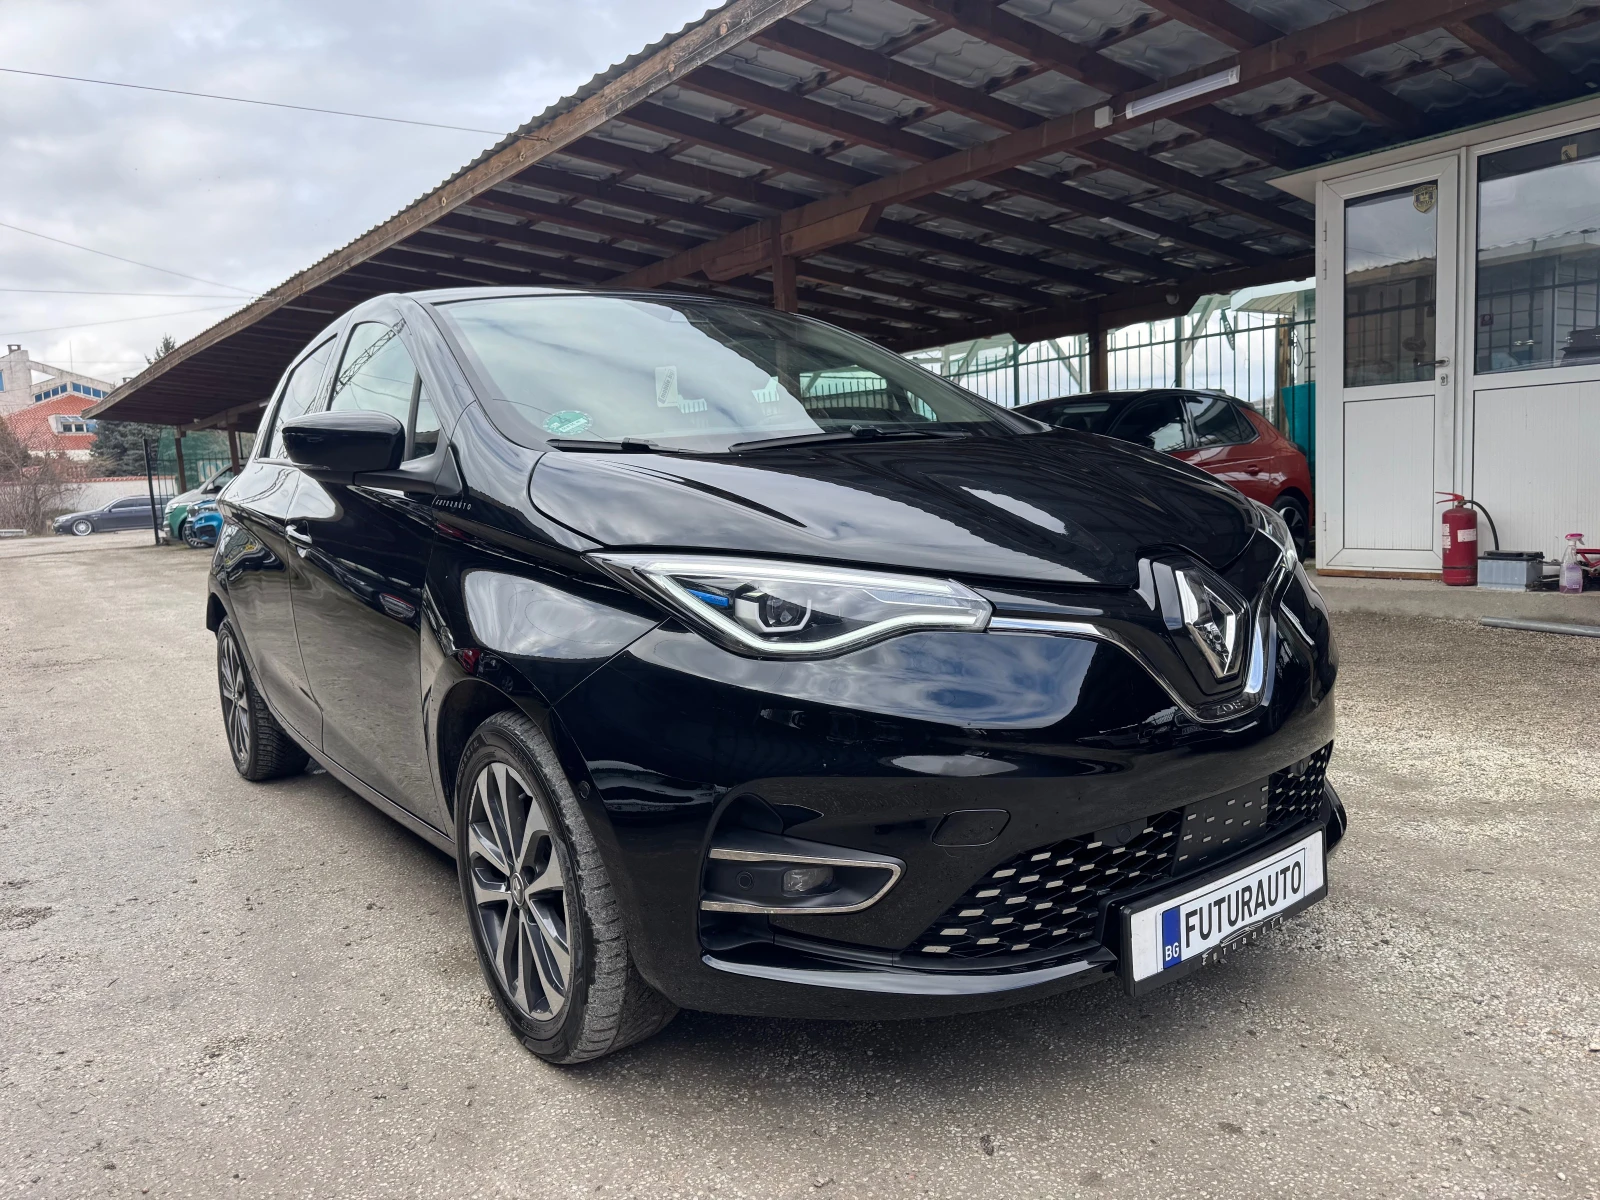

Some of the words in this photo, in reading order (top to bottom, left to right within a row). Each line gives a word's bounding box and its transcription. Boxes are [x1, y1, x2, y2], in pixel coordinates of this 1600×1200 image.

[1213, 700, 1244, 715] ZOE
[1185, 860, 1301, 949] FUTURAUTO
[1165, 942, 1180, 961] BG
